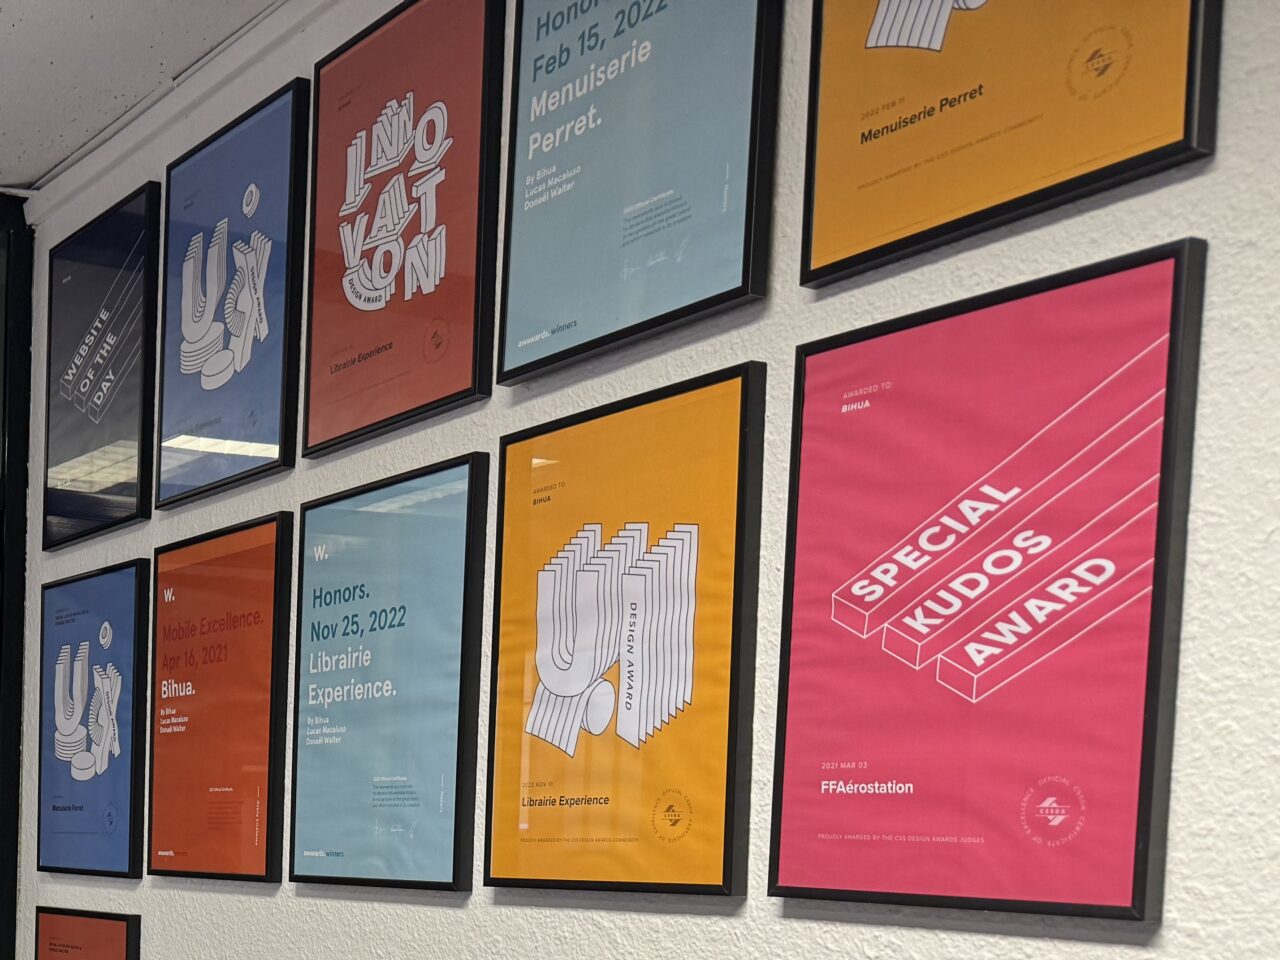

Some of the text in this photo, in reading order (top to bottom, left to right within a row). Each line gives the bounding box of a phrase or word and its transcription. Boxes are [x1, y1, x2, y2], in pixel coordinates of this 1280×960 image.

[532, 43, 570, 83] Feb
[577, 22, 607, 56] 15,
[530, 40, 652, 122] Menuiserie
[860, 83, 984, 144] Menuiserie Perret
[528, 103, 602, 160] Perret.
[525, 174, 534, 186] By
[525, 165, 582, 198] Lucas Macaluso
[550, 180, 575, 198] Walter
[348, 277, 383, 304] DESIGN AWARD
[64, 307, 110, 381] WEBSITE
[330, 356, 357, 375] Librairie
[357, 341, 394, 364] Experience
[80, 332, 118, 393] OF THE
[93, 369, 116, 405] DAY
[842, 384, 878, 400] AWARDED
[841, 400, 870, 412] BIHUA
[532, 496, 552, 506] BIHUA
[314, 544, 329, 562] W.
[851, 484, 1022, 602] SPECIAL
[164, 588, 176, 603] W.
[312, 583, 370, 608] Honors.
[902, 530, 1052, 635] KUDOS
[163, 610, 264, 642] Mobile Excellence.
[311, 605, 407, 642] Nov 25, 2022
[964, 558, 1116, 667] AWARD
[162, 643, 228, 674] Apr 16, 2021
[309, 645, 372, 674] Librairie
[624, 602, 638, 712] DESIGN AWARD
[161, 679, 196, 698] Bihua.
[308, 679, 397, 709] Experience.
[306, 726, 347, 736] Lucas Macaluso
[307, 716, 314, 726] By
[324, 736, 342, 744] Walter
[858, 761, 868, 769] 03
[522, 794, 610, 808] Librairie Experience
[820, 780, 914, 794] FFAérostation
